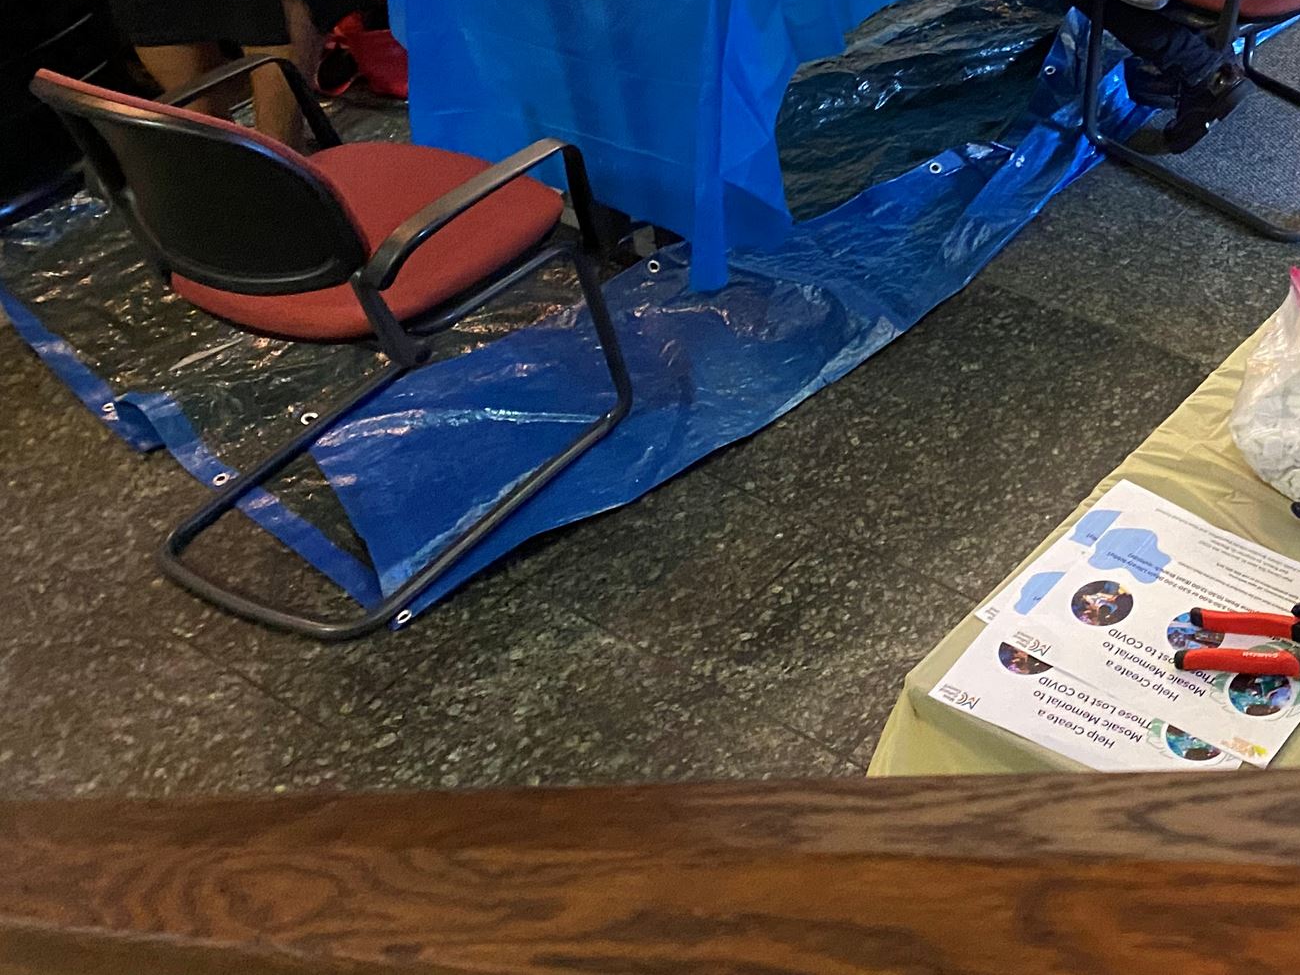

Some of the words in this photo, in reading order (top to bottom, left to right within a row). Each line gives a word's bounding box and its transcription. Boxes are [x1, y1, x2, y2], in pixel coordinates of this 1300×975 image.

[1103, 642, 1114, 651] to
[1108, 629, 1143, 649] COVID
[1145, 646, 1156, 656] to
[1156, 651, 1174, 664] ost
[1106, 660, 1114, 668] a
[1114, 648, 1166, 678] Memorial
[1115, 665, 1150, 687] Create
[1039, 676, 1075, 696] COVID
[1152, 684, 1179, 701] Help
[1167, 674, 1206, 697] Mosaic
[1033, 691, 1045, 700] to
[1077, 692, 1089, 702] to
[1038, 709, 1047, 717] a
[1046, 696, 1100, 724] Memorial
[1091, 698, 1116, 714] Lost
[1047, 714, 1084, 735] Create
[1118, 710, 1152, 730] Those
[1087, 731, 1115, 748] Help
[1102, 720, 1142, 742] Mosaic
